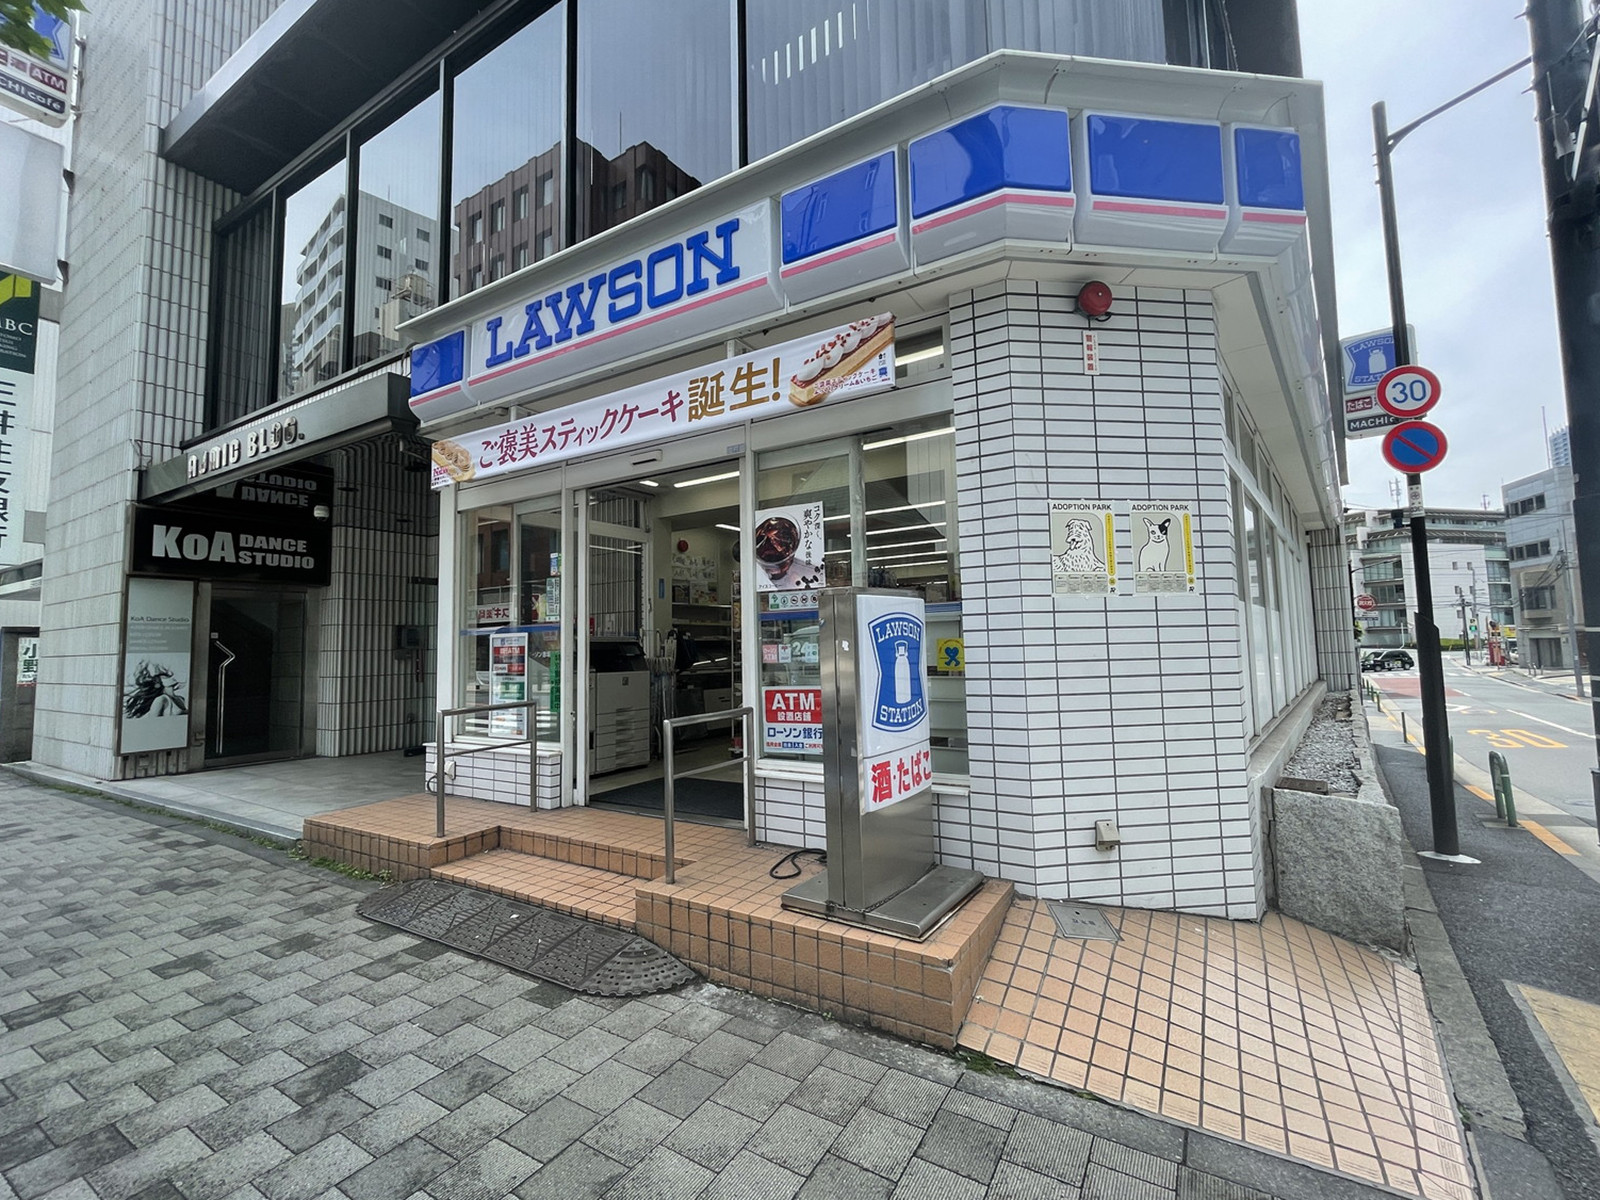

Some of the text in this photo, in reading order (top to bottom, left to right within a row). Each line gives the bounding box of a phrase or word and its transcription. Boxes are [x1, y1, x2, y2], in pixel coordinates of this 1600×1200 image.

[32, 67, 65, 91] ATM
[485, 218, 740, 368] LAWSON
[1351, 337, 1395, 353] LAWSO
[1391, 379, 1427, 404] 30
[1347, 398, 1372, 412] たばこ
[1350, 417, 1388, 430] MACHI
[1052, 503, 1112, 511] ADOPTION PARK
[239, 534, 307, 553] DANCE
[238, 551, 315, 569] STUDIO
[876, 621, 920, 643] LAWSON
[772, 693, 815, 710] ATM
[880, 698, 922, 722] STATION
[768, 727, 823, 739] ローソン銀行
[1467, 729, 1569, 748] 30
